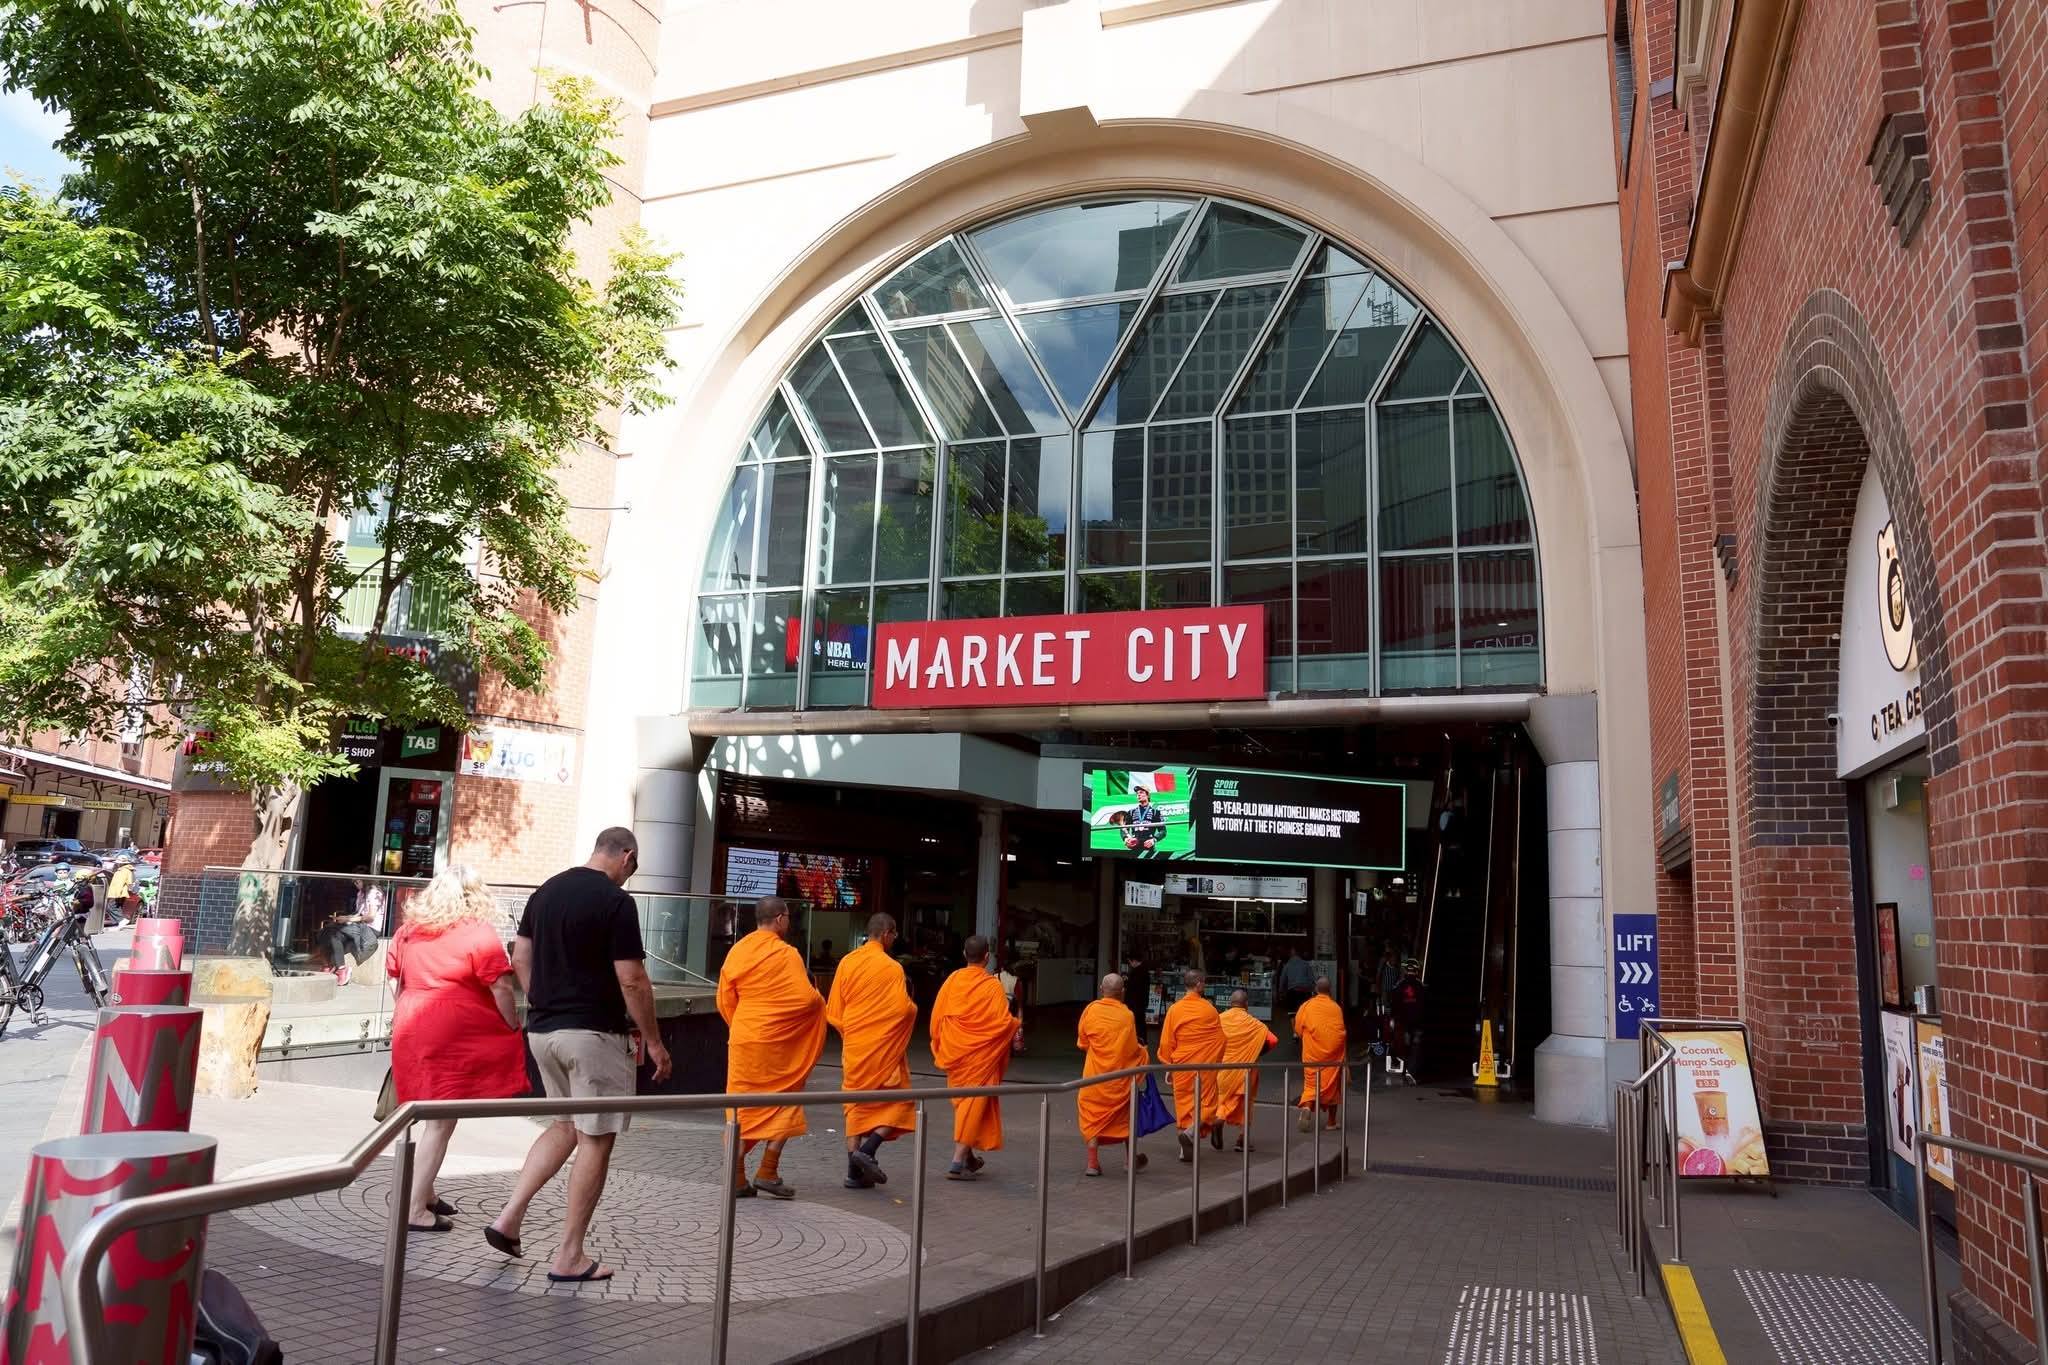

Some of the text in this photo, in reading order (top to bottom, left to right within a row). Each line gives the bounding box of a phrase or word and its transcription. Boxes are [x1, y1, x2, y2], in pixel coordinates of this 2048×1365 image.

[827, 641, 851, 658] NBA
[885, 623, 1248, 690] MARKET CITY
[828, 659, 850, 668] HERE
[1871, 714, 1878, 740] C
[1880, 700, 1902, 735] TEA
[406, 736, 436, 749] TAB
[351, 748, 375, 758] SHOP
[1214, 780, 1239, 789] SPORT
[1213, 801, 1257, 816] 19-YEAR-OLD
[1258, 803, 1273, 817] KIMI
[1310, 807, 1330, 821] MAKES
[1331, 809, 1360, 824] HISTORIC
[1212, 817, 1341, 838] VICTORY AT THE F1 CHINESE GRAND PRIX
[735, 856, 771, 866] SOUVENIRS
[1617, 934, 1654, 951] LIFT
[1681, 1046, 1724, 1055] Coconut
[1670, 1057, 1737, 1068] Mango Sago
